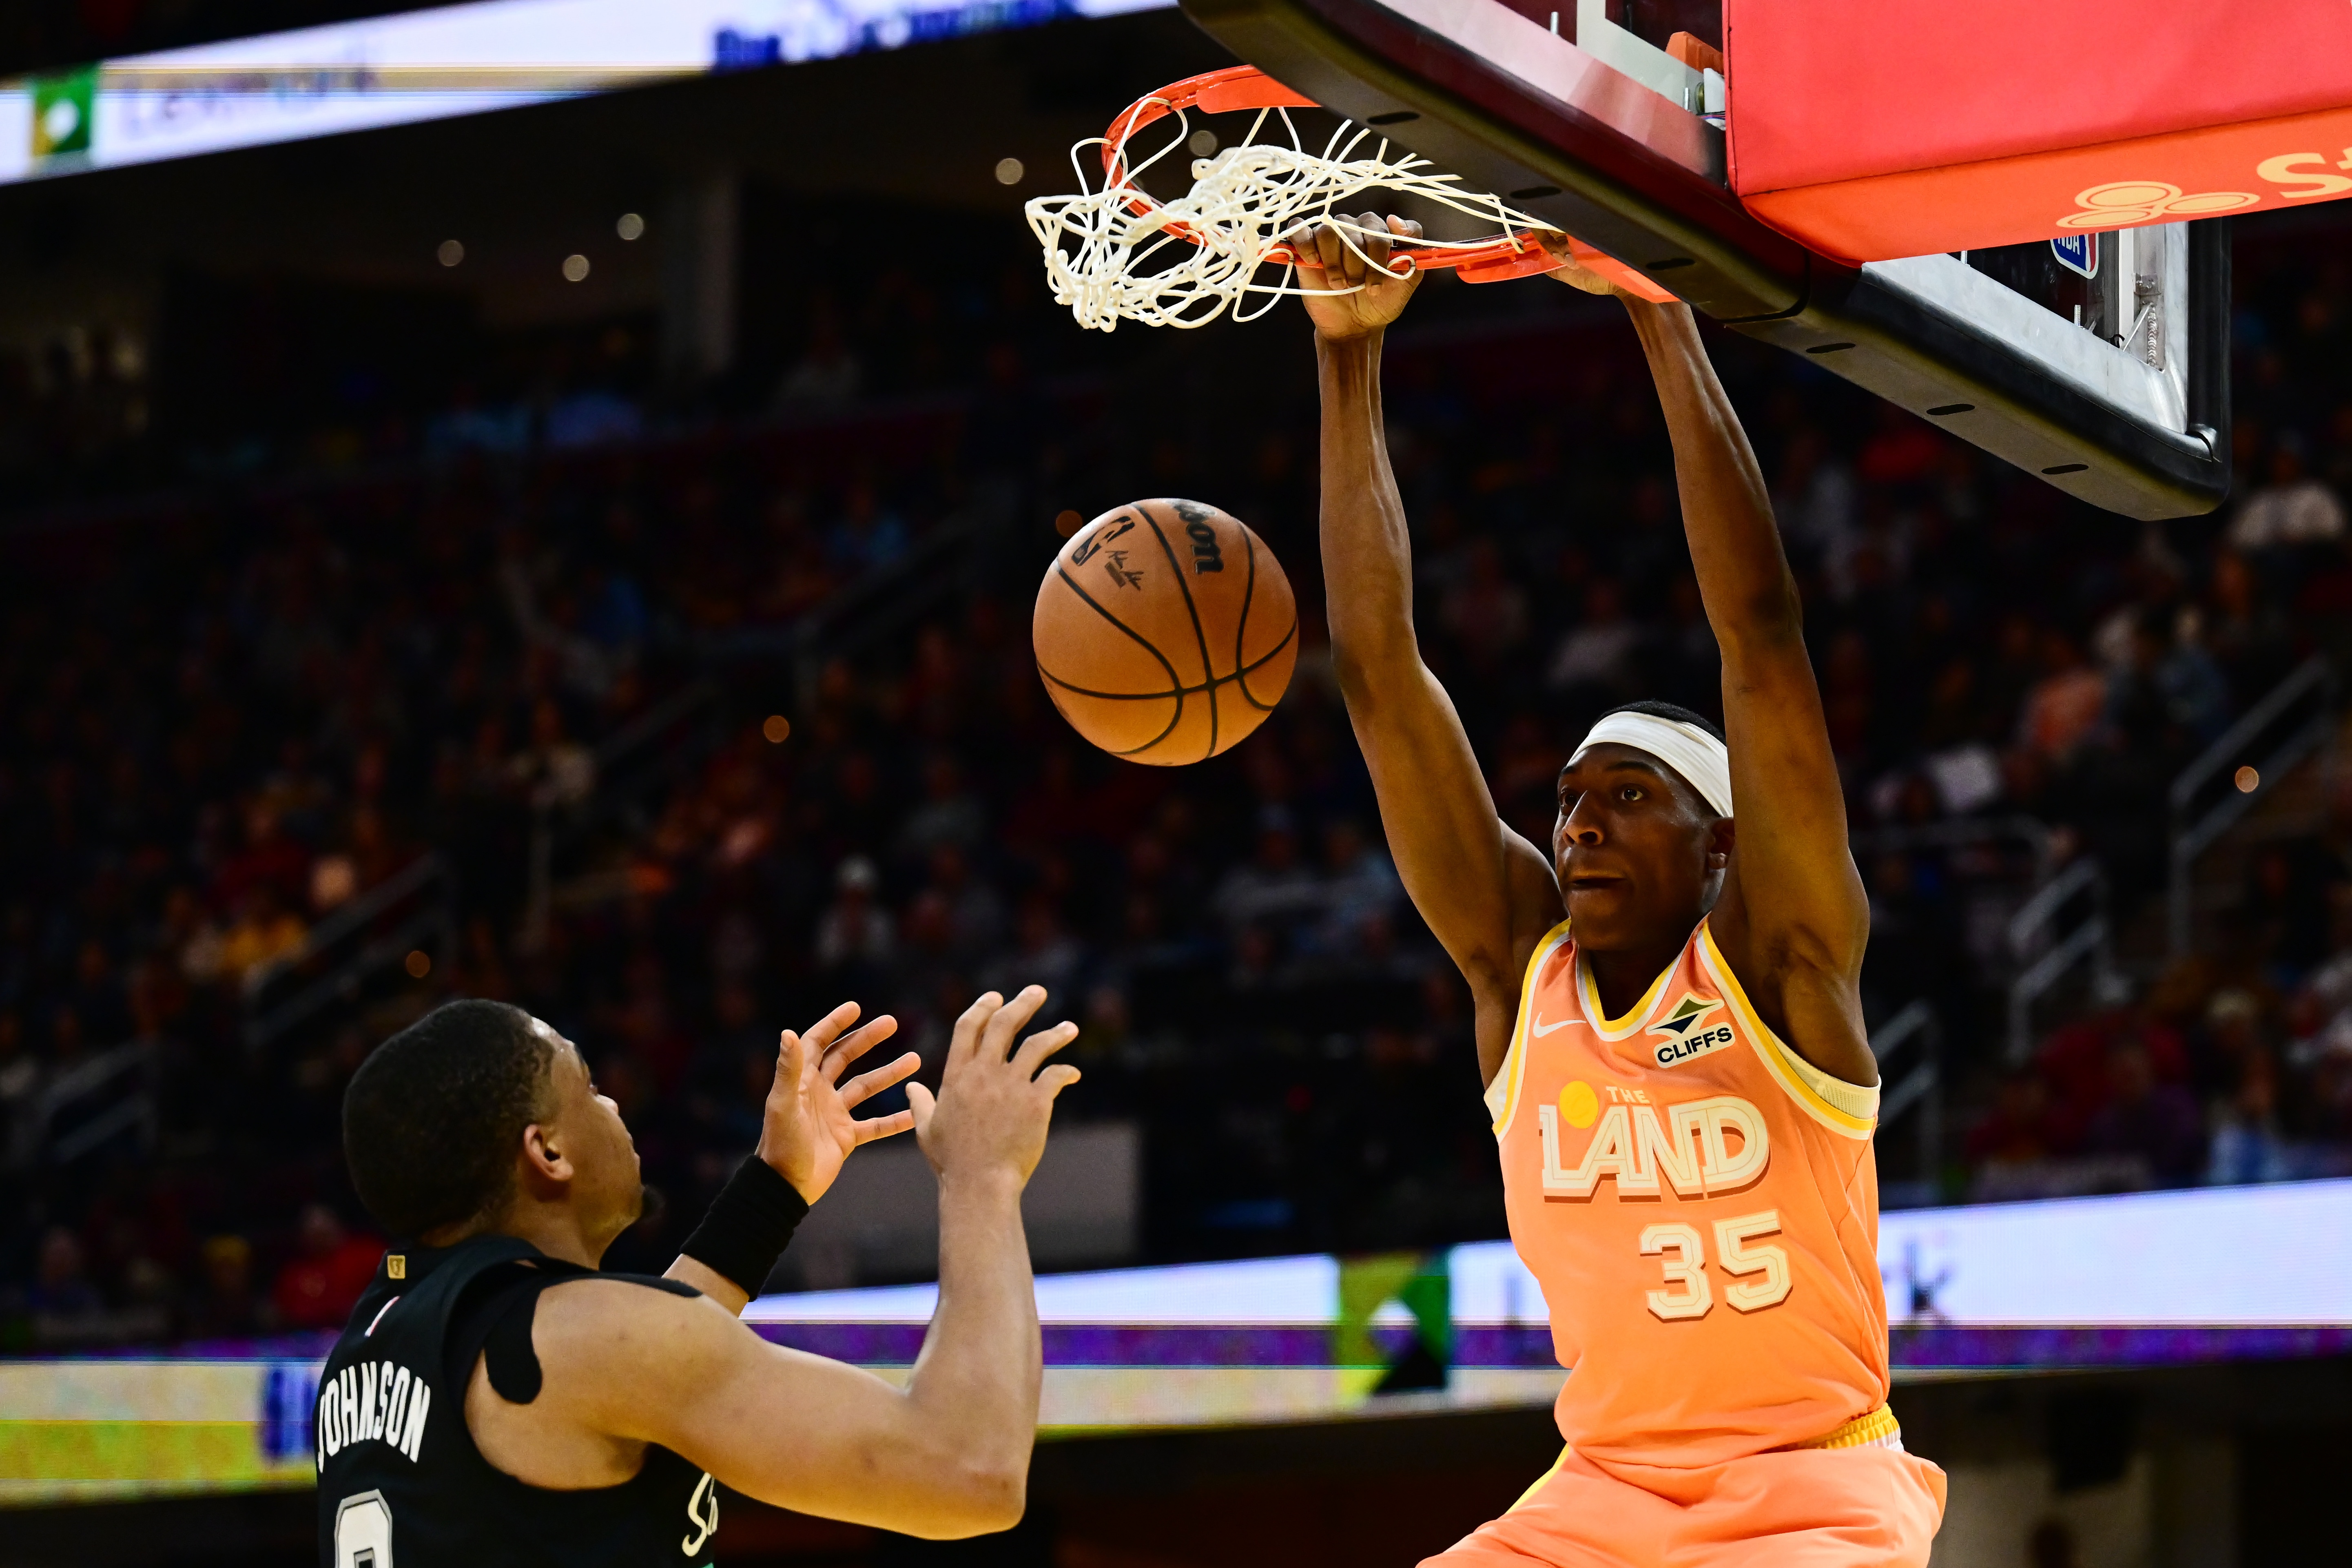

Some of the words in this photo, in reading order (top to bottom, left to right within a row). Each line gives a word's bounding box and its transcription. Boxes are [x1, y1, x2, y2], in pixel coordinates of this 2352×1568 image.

[2257, 147, 2352, 198] S
[1657, 1027, 1732, 1063] CLIFFS
[1606, 1086, 1650, 1103] THE
[1539, 1096, 1771, 1203] LAND
[1639, 1209, 1793, 1323] 35
[318, 1360, 431, 1473] JOHNSON
